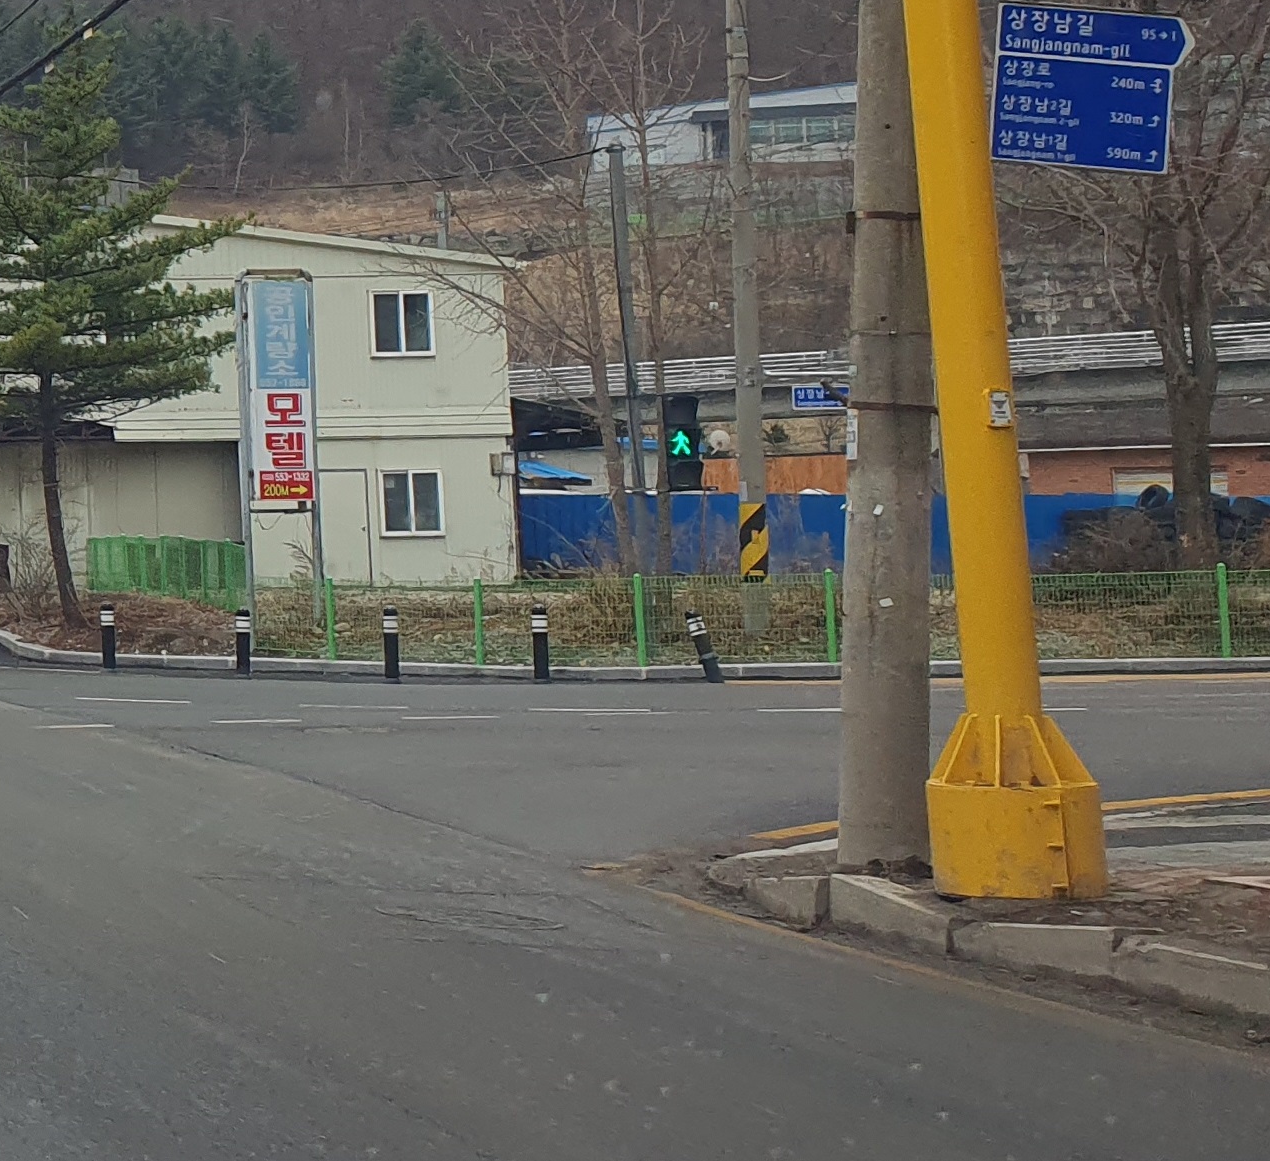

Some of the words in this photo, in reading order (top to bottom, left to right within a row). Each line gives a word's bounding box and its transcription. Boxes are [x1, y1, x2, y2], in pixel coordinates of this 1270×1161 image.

[1007, 9, 1095, 37] 상장남길
[1005, 34, 1131, 59] Sangjangnam-gil
[1003, 59, 1052, 77] 상장로
[1111, 77, 1146, 91] 240m
[1001, 93, 1072, 116] 상장남2길
[1109, 112, 1144, 126] 320m
[998, 128, 1068, 151] 상장남1길
[1106, 147, 1142, 161] 590m
[264, 393, 306, 469] 모텔
[263, 483, 289, 497] 200M
